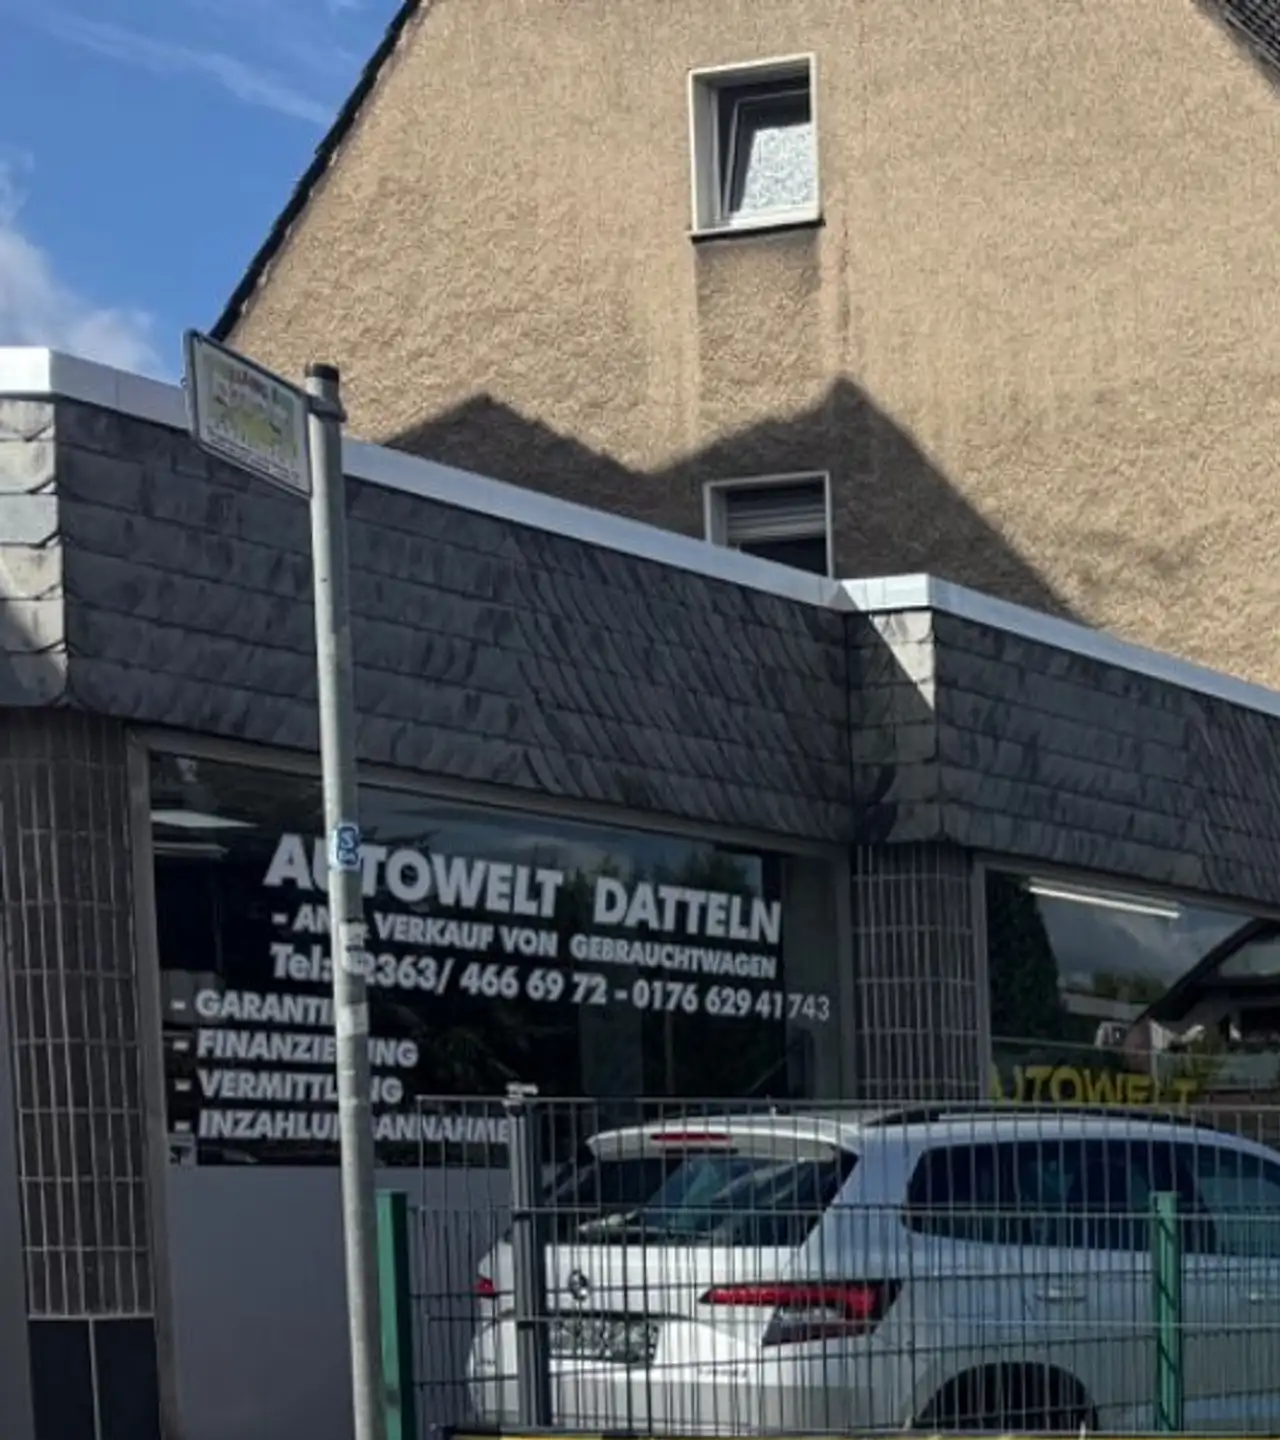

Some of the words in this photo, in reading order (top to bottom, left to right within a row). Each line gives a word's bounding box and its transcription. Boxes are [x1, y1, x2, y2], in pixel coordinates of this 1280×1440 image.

[594, 876, 781, 943] DATTELN
[374, 910, 492, 951] VERKAUF
[500, 926, 558, 957] VON
[570, 934, 777, 979] GEBRAUCHTWAGEN
[270, 942, 332, 983] Tel:
[459, 961, 519, 997] 466
[526, 967, 565, 1001] 69
[570, 972, 607, 1005] 72
[632, 978, 699, 1014] 0176
[705, 984, 753, 1017] 629
[196, 989, 334, 1027] GARANTI
[197, 1028, 419, 1067] FINANZIENG
[198, 1067, 403, 1104] VERMITTLG
